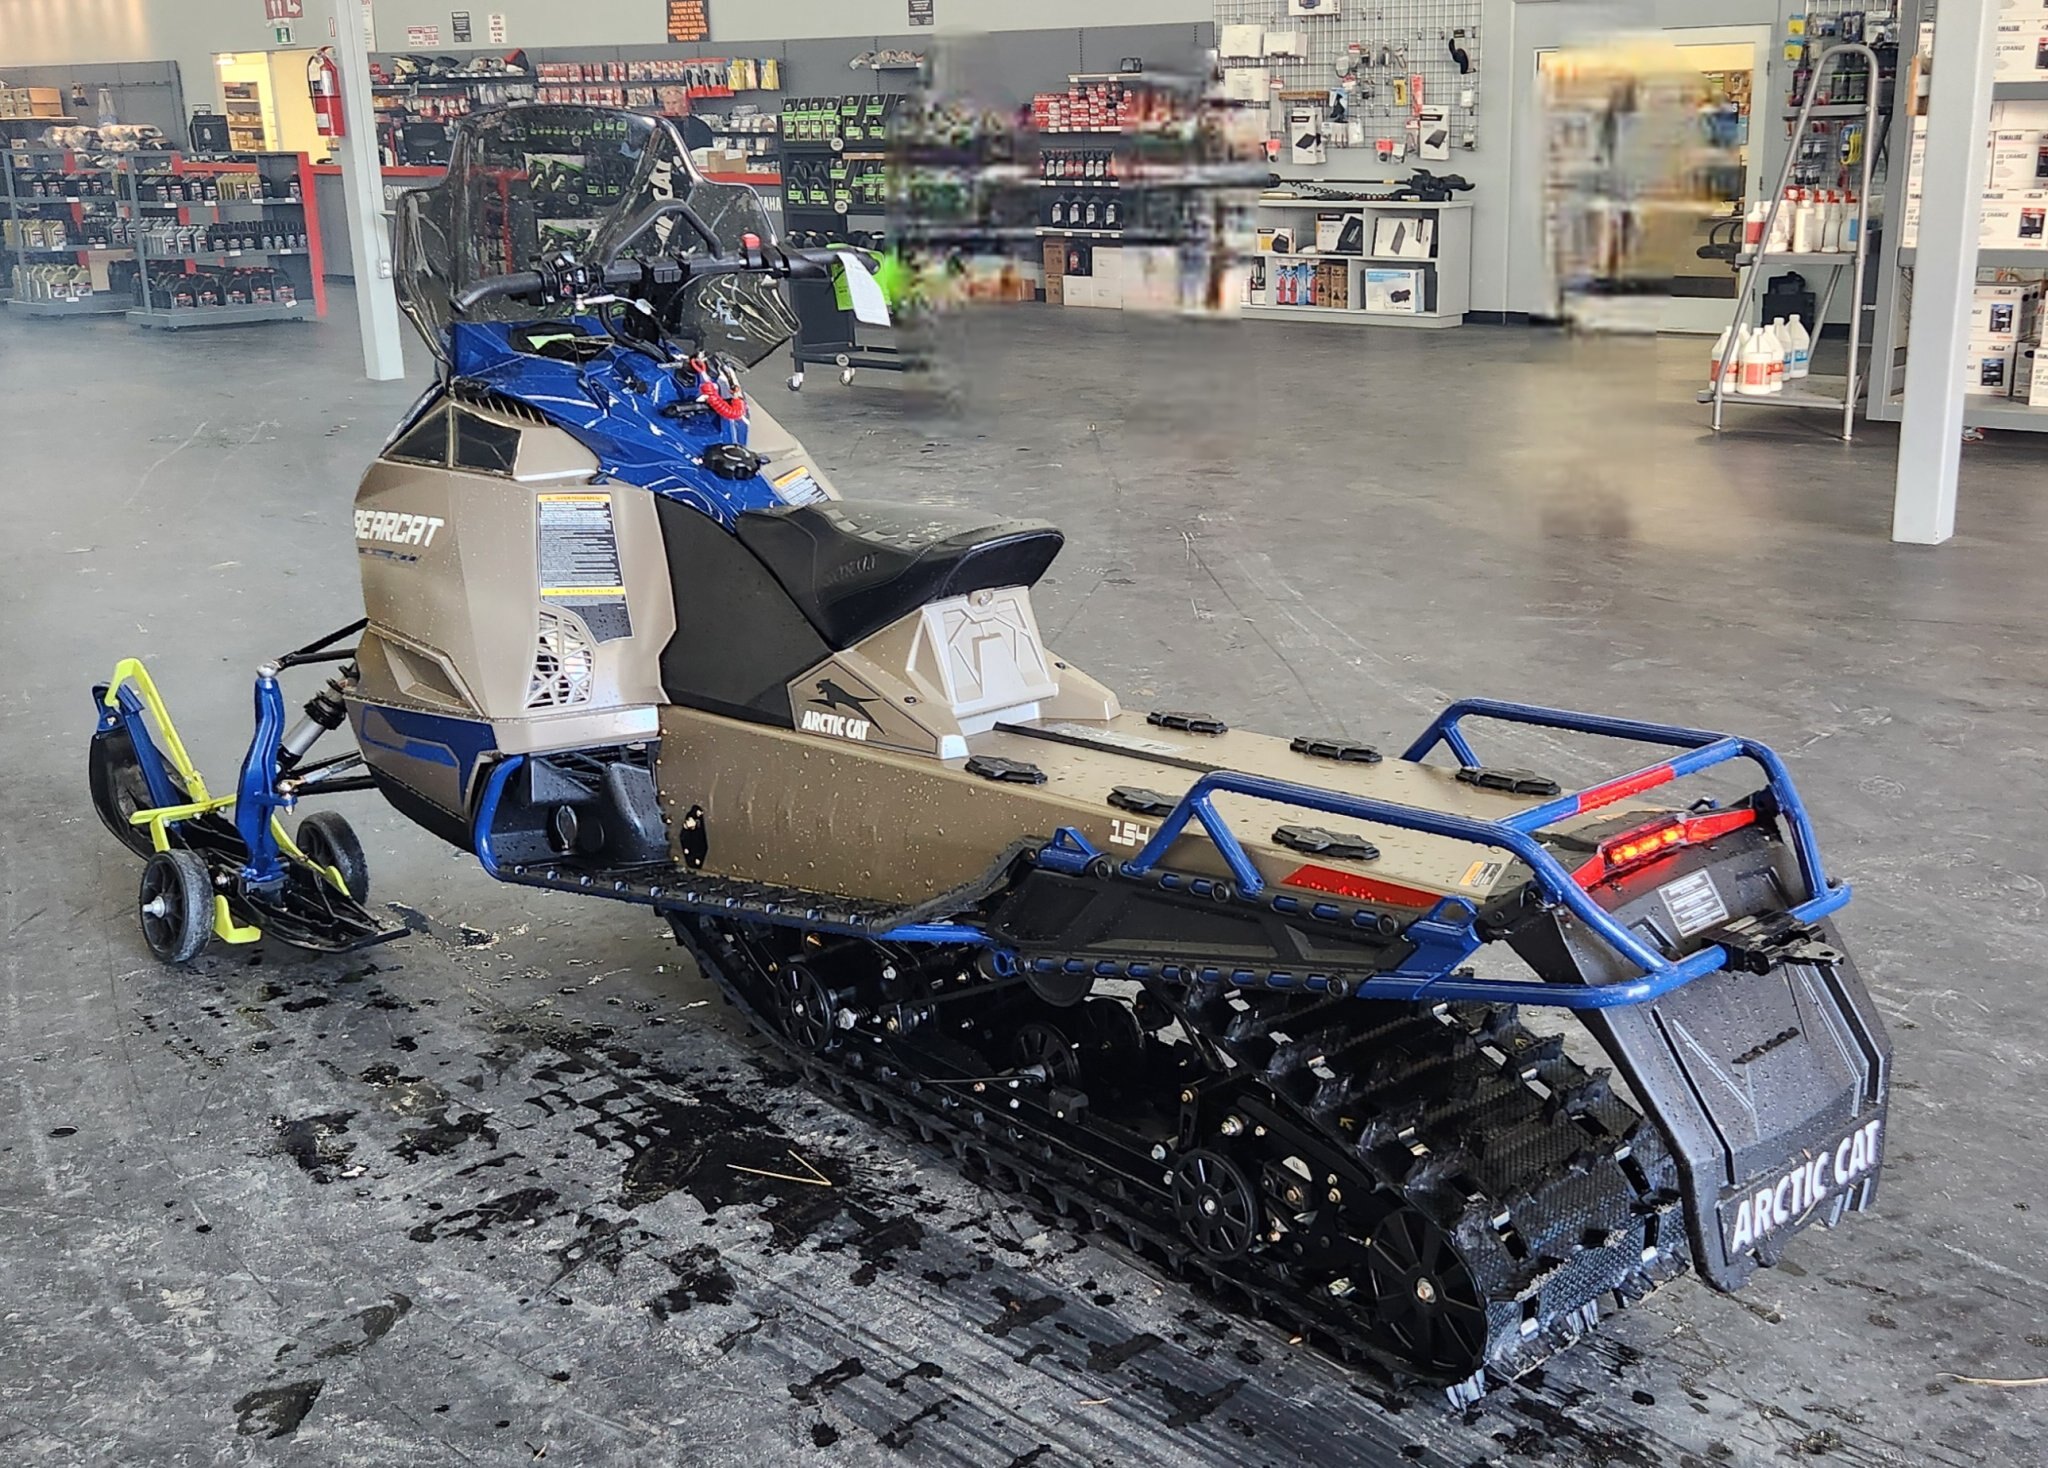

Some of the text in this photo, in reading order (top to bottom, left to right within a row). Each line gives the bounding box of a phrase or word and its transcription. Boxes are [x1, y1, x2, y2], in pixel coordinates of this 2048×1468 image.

[354, 509, 445, 547] BEARCAT
[801, 710, 871, 741] ARCTIC CAT
[1109, 819, 1150, 847] 154
[1732, 1119, 1882, 1254] ARCTIC CAT
